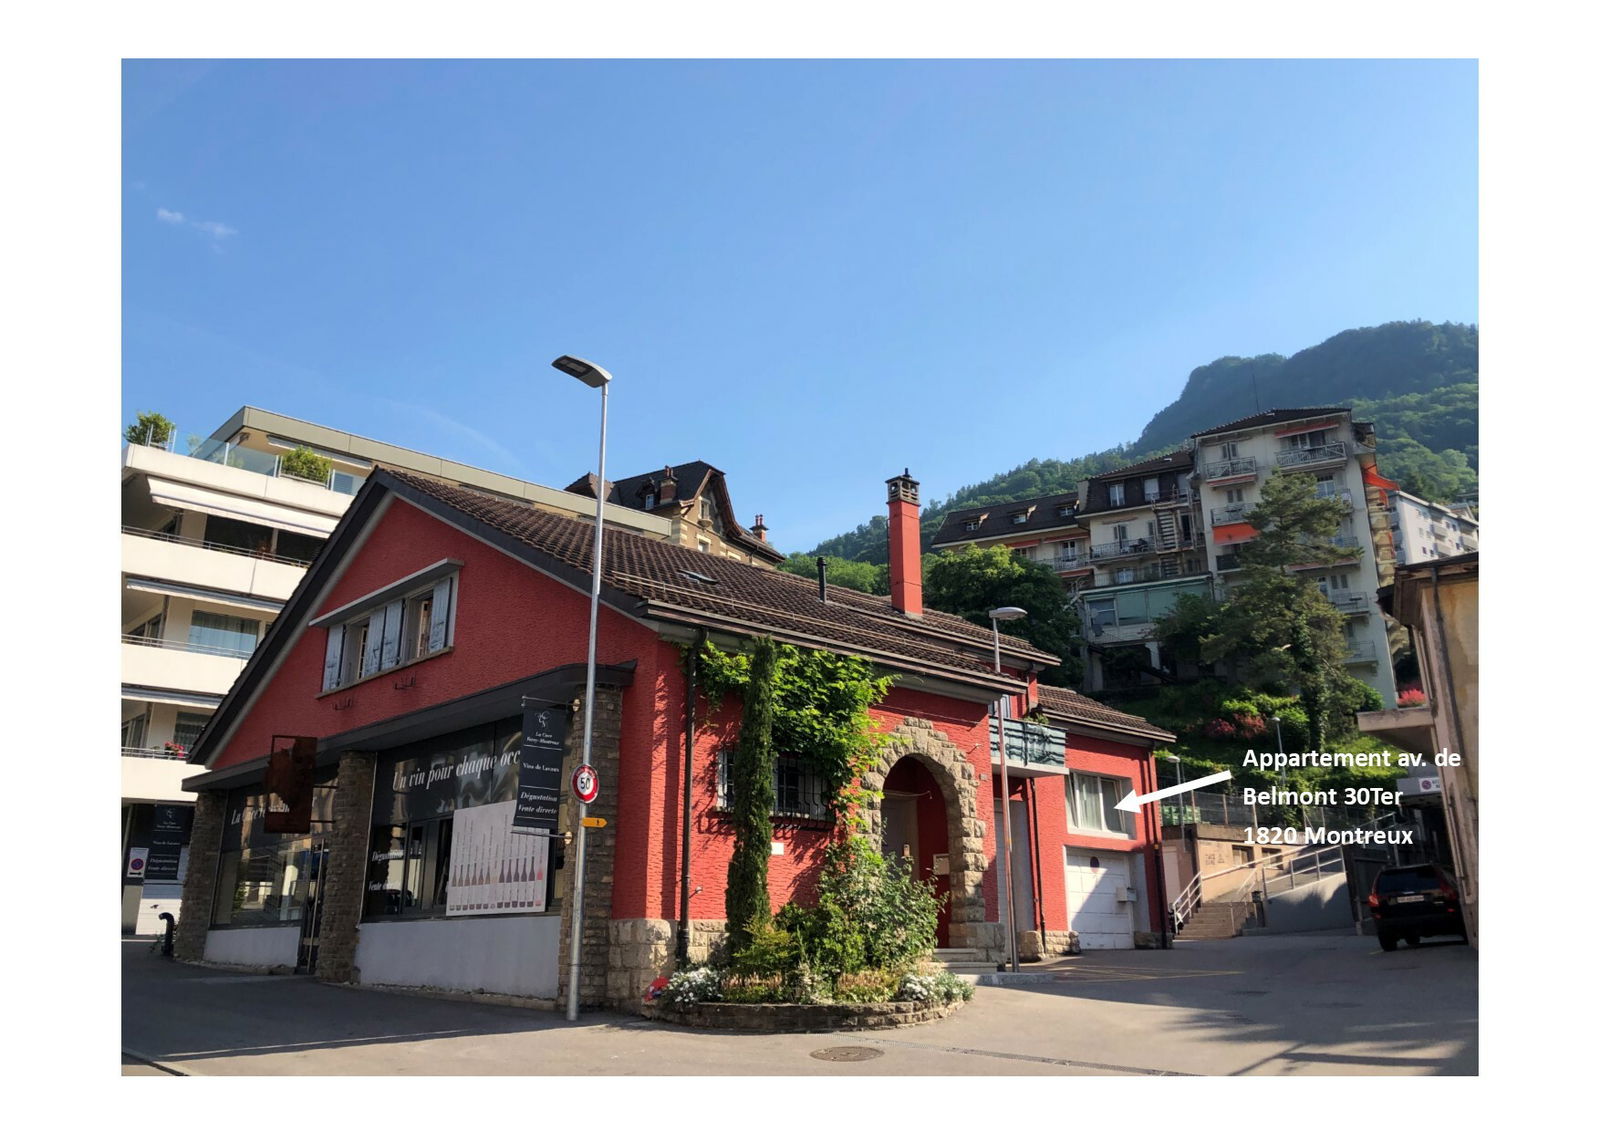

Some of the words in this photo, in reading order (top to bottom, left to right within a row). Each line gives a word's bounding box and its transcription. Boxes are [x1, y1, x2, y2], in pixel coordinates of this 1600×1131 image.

[392, 770, 407, 791] Un
[408, 767, 426, 787] vin
[425, 764, 454, 790] pour
[455, 754, 498, 779] chaque
[500, 750, 520, 766] occ
[580, 777, 591, 790] 50
[520, 791, 558, 802] Dégustation
[518, 804, 535, 813] Vente
[535, 805, 557, 814] directe
